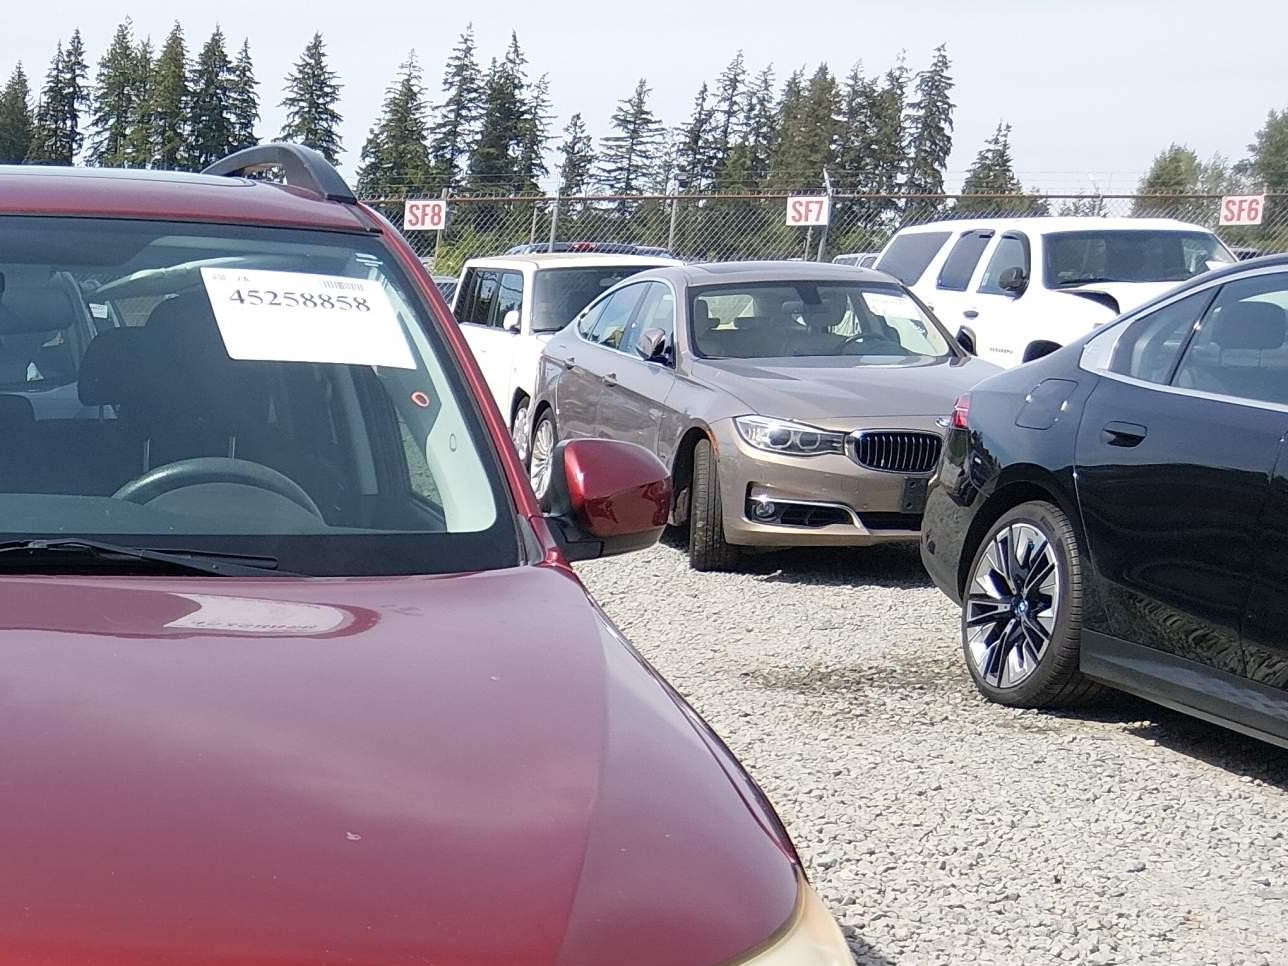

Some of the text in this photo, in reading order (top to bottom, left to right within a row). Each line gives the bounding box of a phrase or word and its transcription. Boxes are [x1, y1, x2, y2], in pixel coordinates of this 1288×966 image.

[407, 203, 442, 226] SF8
[791, 200, 824, 222] SF7
[1223, 199, 1260, 222] SF6
[228, 288, 371, 312] 45258858
